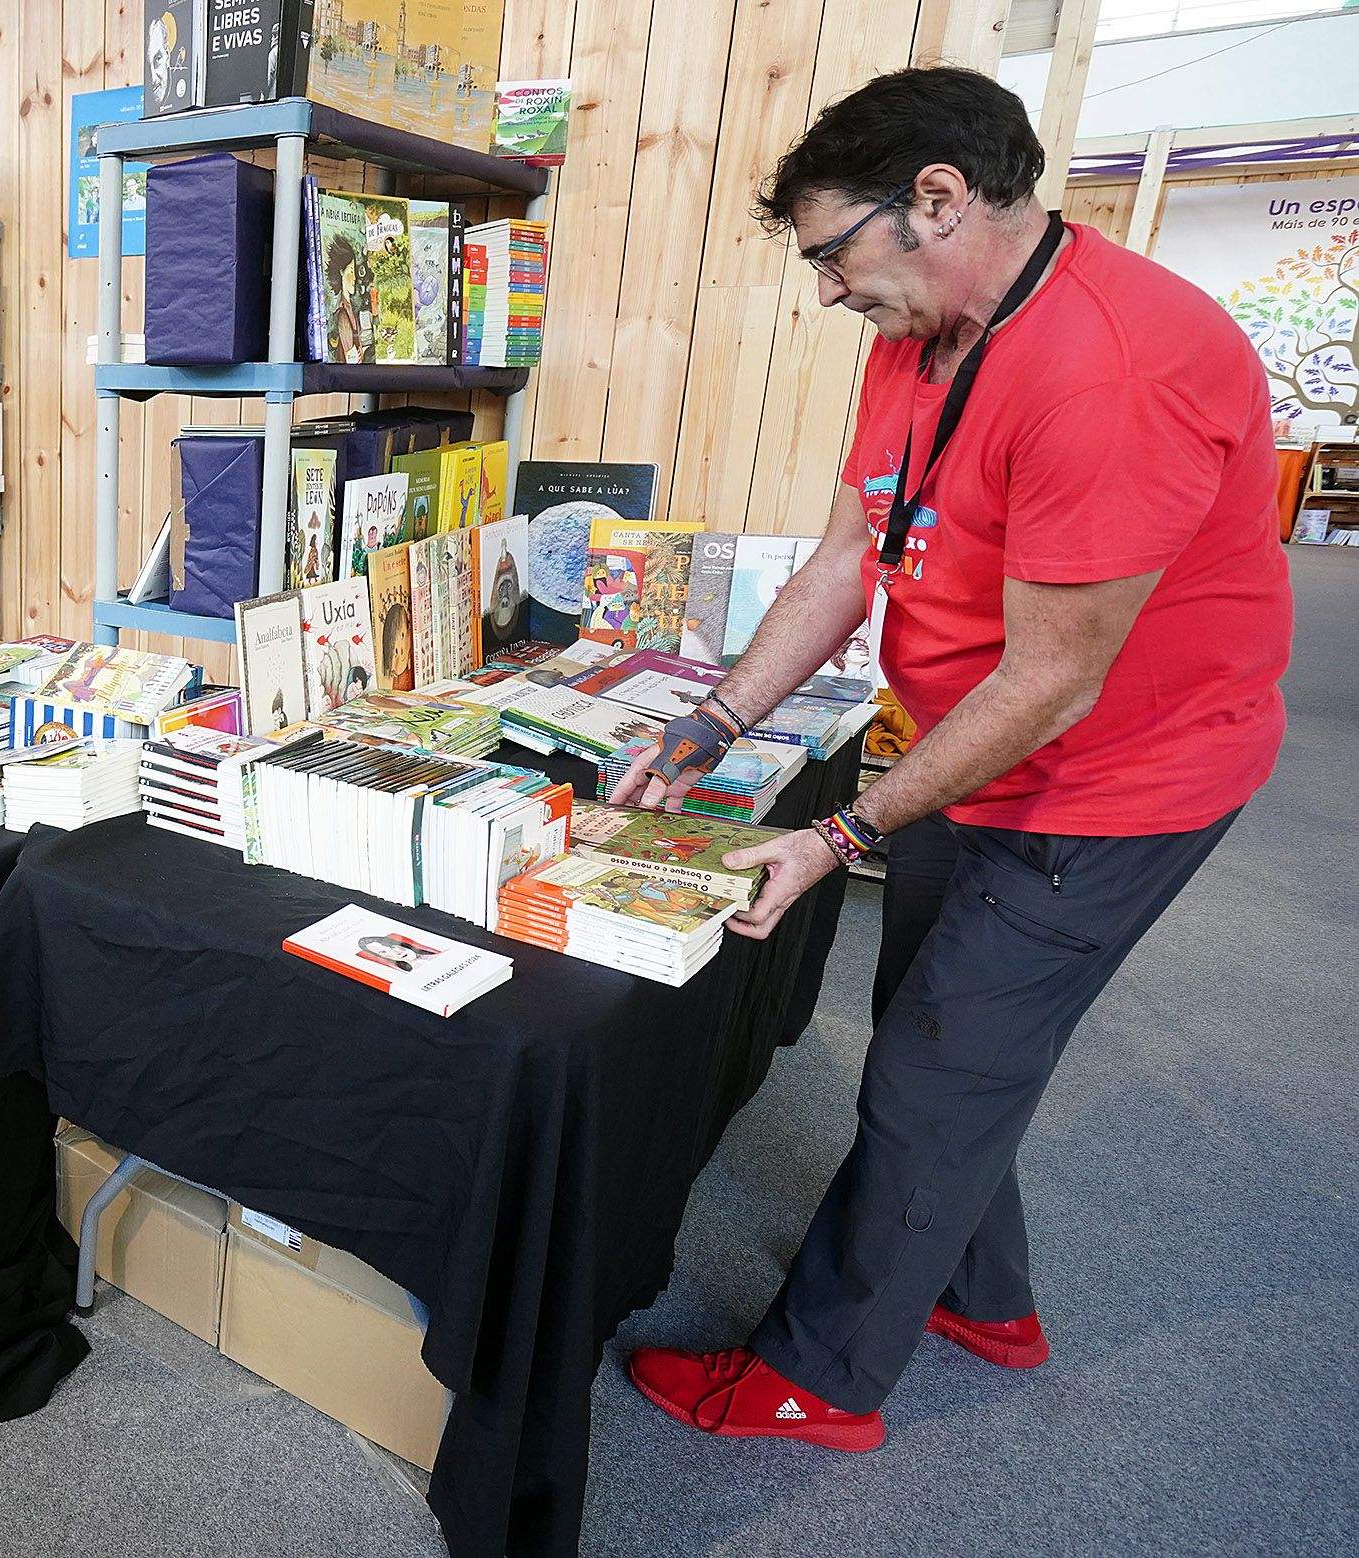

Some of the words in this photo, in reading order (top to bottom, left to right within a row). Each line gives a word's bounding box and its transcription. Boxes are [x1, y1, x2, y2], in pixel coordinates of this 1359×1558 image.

[213, 7, 260, 31] LIBRES
[212, 36, 221, 52] E
[224, 28, 263, 50] VIVAS
[514, 87, 563, 97] CONTOS
[519, 105, 558, 115] ROXAL
[1269, 199, 1301, 216] Un
[1309, 198, 1359, 216] esp
[1272, 219, 1304, 230] Máis
[1308, 219, 1327, 228] de
[1331, 216, 1349, 227] 90
[306, 468, 324, 482] SETE
[538, 484, 544, 492] A
[548, 485, 566, 493] QUE
[570, 486, 593, 494] SABE
[704, 542, 735, 559] OS
[322, 600, 356, 626] Uxía
[255, 624, 293, 646] Analfabeta
[670, 867, 702, 881] bosque
[704, 874, 712, 882] O
[700, 884, 709, 892] O
[420, 977, 444, 993] LETRAS
[775, 1410, 807, 1420] adidas
